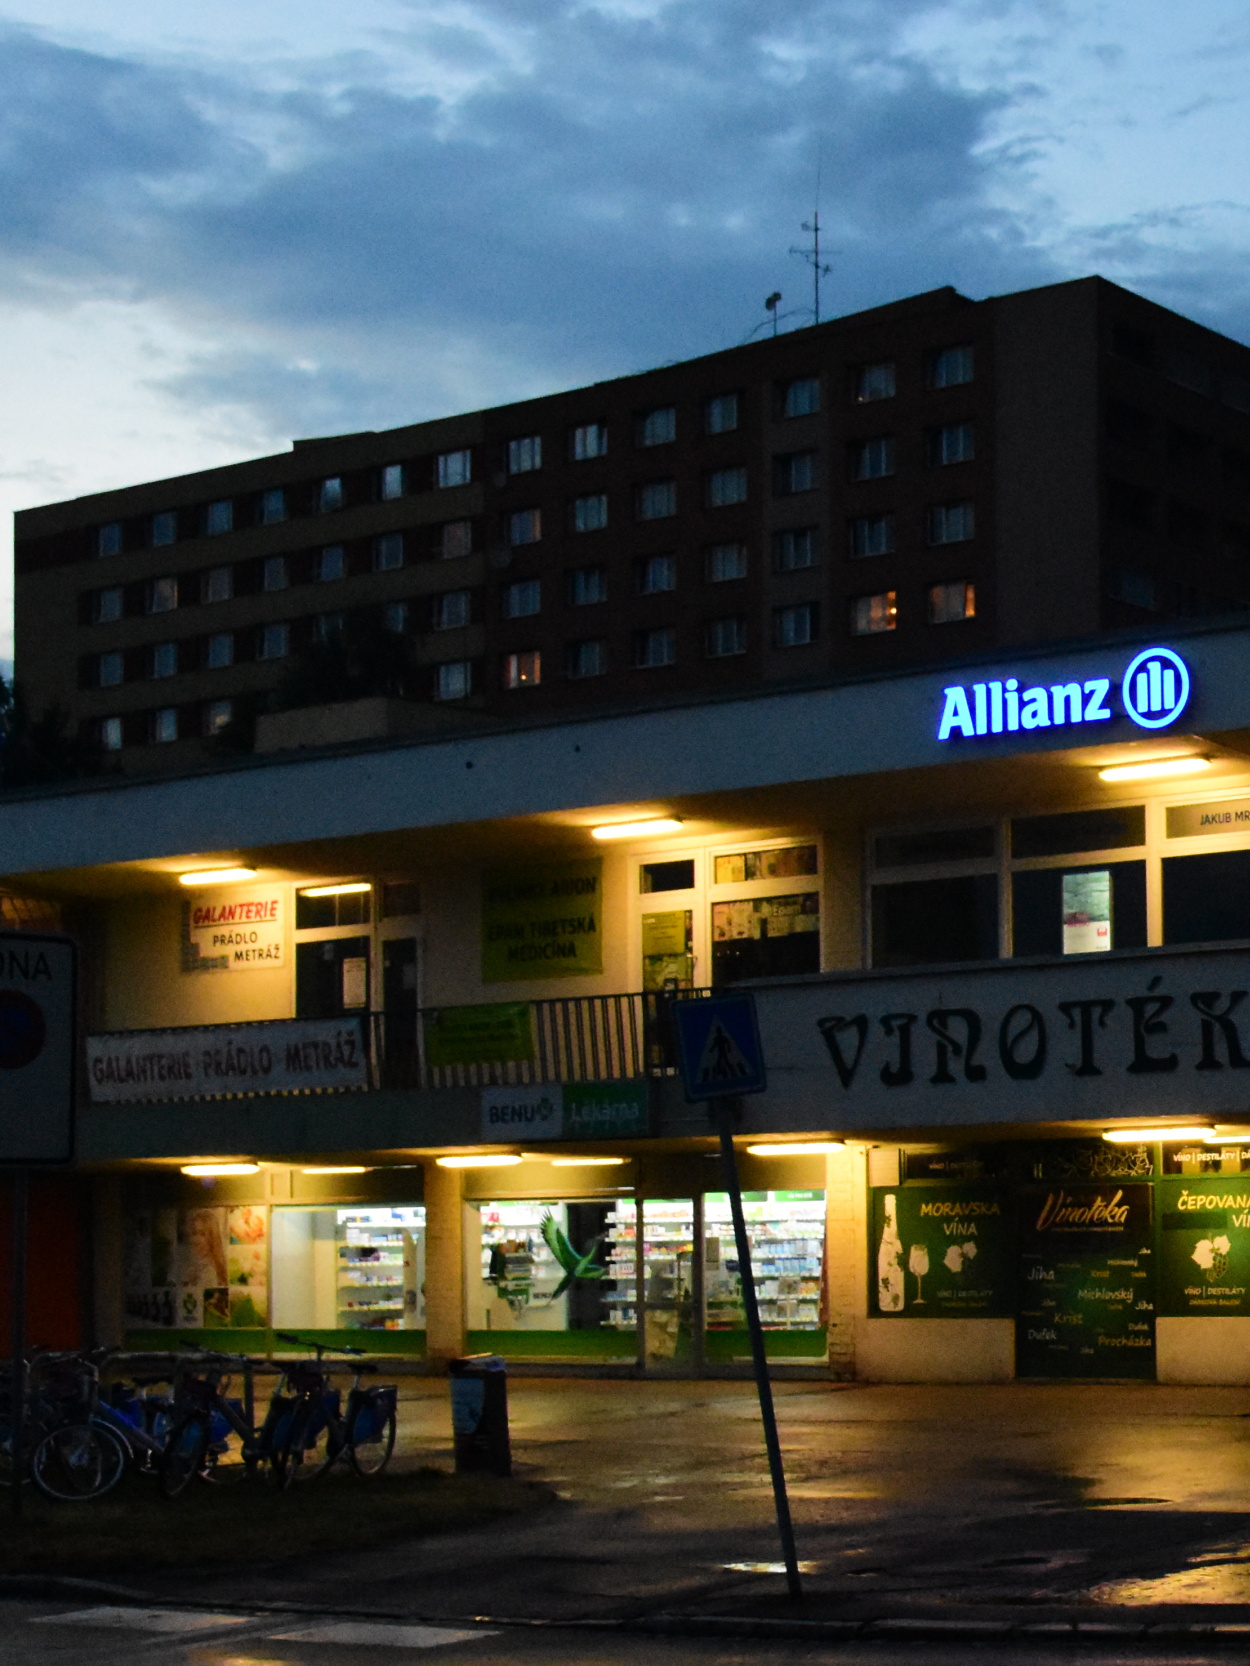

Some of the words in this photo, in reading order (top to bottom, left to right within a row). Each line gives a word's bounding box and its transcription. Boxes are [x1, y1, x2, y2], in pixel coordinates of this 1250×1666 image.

[937, 678, 1111, 740] Allianz
[1200, 811, 1232, 826] JAKUB
[193, 899, 279, 925] GALANTERIE
[213, 930, 259, 948] PRÁDLO
[234, 946, 281, 963] METRÁŽ
[0, 950, 53, 981] NA
[93, 1051, 193, 1086] GALANTERIE
[203, 1039, 273, 1079] PRÁDLO
[286, 1031, 359, 1072] METRÁŽ
[488, 1104, 535, 1124] BENU
[1197, 1150, 1236, 1161] DESTILÁTY
[943, 1216, 979, 1237] VÍNA
